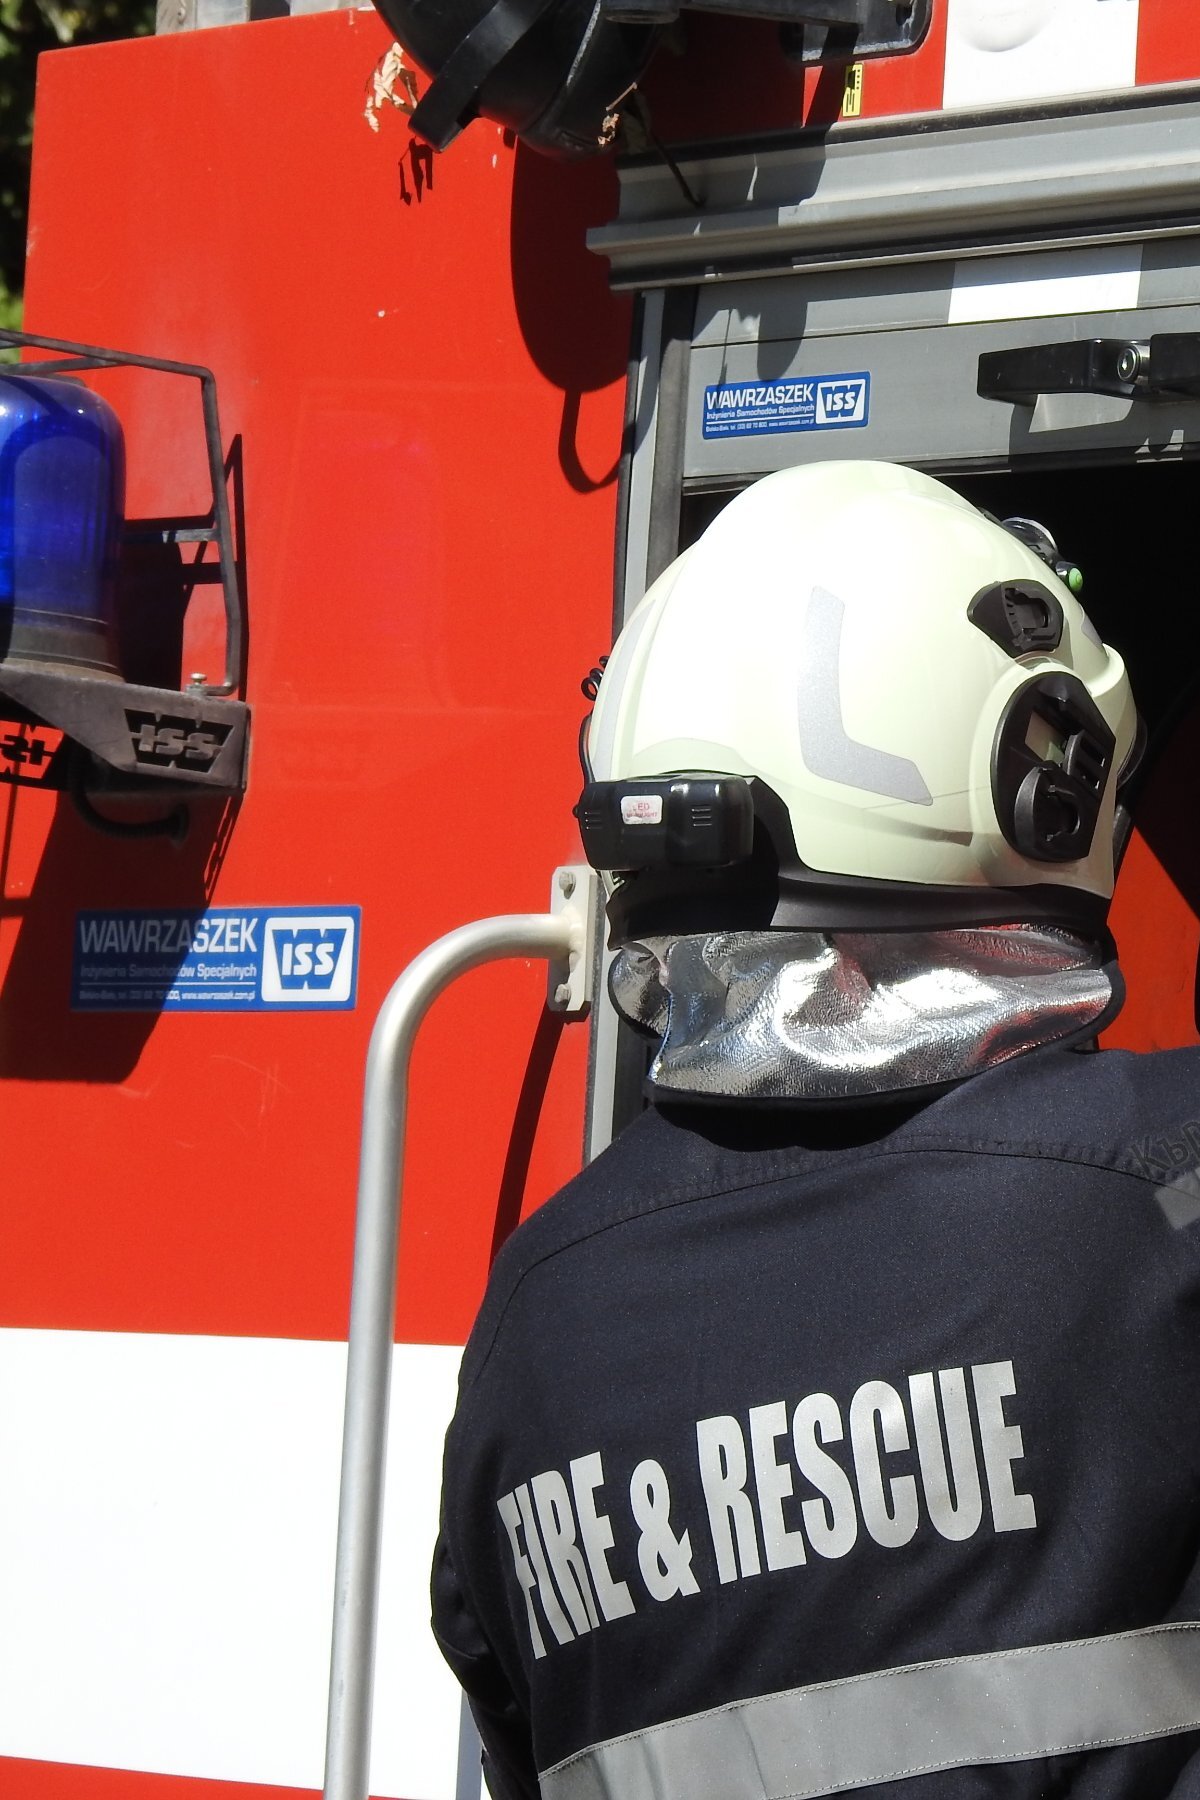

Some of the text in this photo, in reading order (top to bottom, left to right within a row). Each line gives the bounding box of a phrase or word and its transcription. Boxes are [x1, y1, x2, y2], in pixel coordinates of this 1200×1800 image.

[706, 383, 814, 410] WAWRZASZEK
[826, 390, 857, 412] ISS
[79, 917, 259, 953] WAWRZASZEK
[197, 963, 257, 980] Specjalnych
[281, 942, 335, 976] ISS
[497, 1360, 1038, 1660] FIRE & RESCUE
